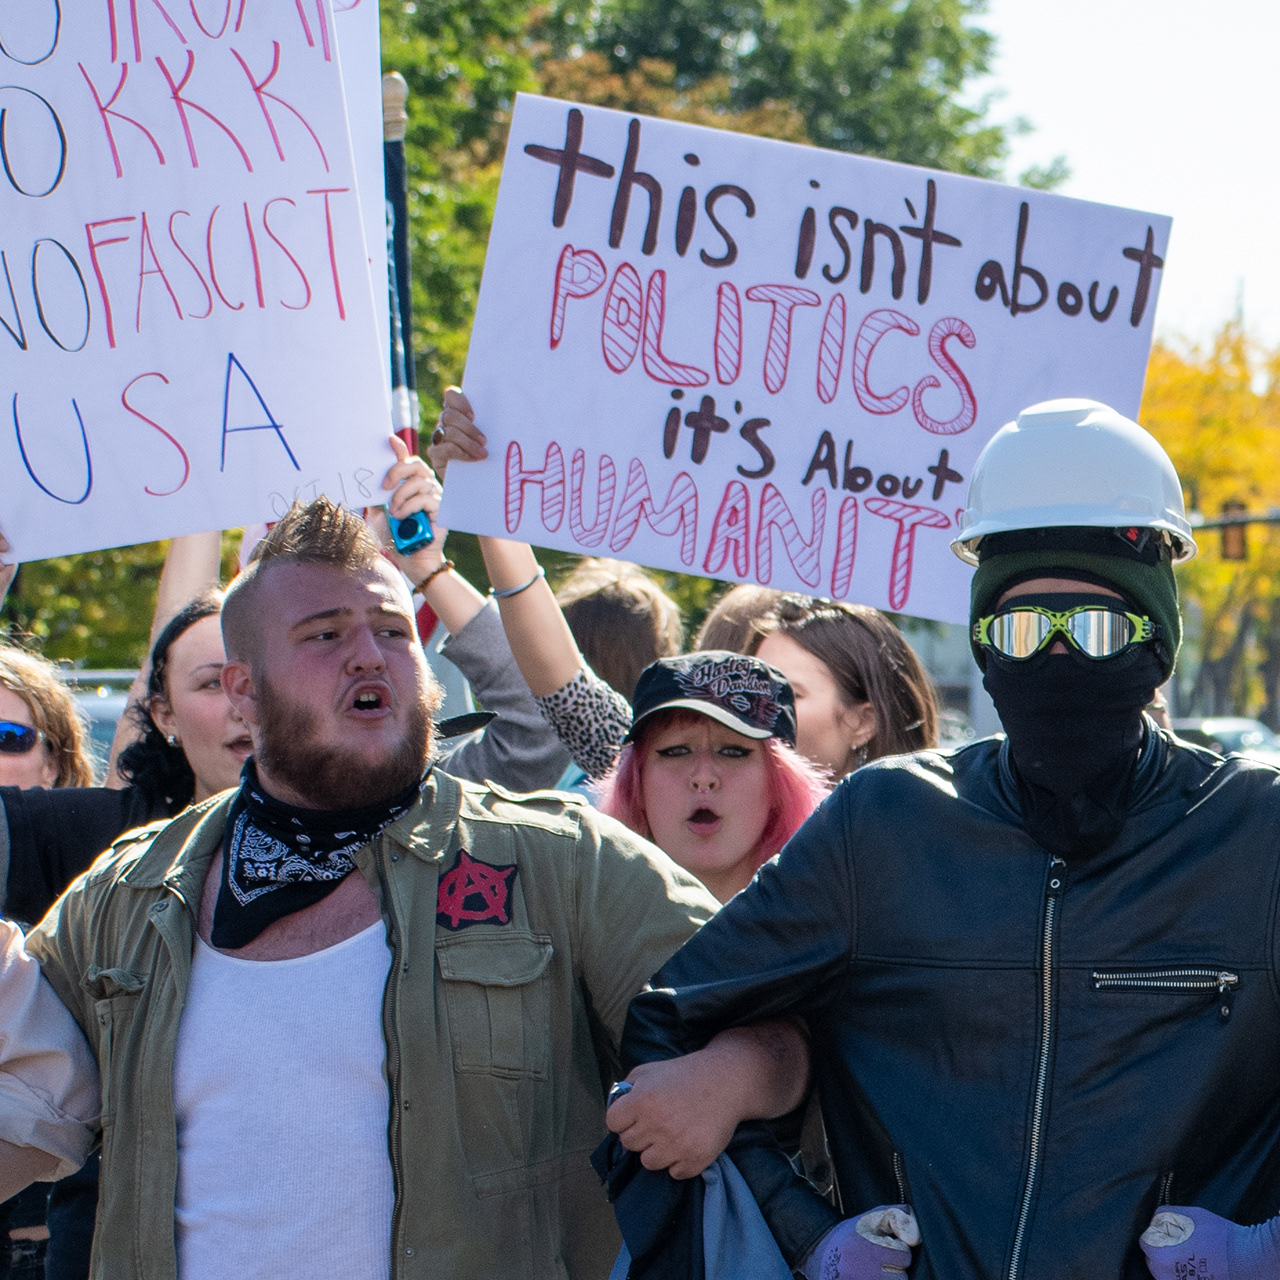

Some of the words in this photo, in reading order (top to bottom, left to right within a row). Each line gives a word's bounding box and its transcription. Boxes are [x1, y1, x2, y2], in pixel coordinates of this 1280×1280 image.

[77, 40, 331, 180] KKK
[85, 188, 350, 349] FASCIST
[524, 106, 756, 270] this
[795, 179, 962, 306] isn't
[974, 201, 1164, 328] about
[549, 242, 978, 436] POLITICS
[662, 388, 777, 481] it's
[802, 429, 964, 502] About
[504, 440, 964, 612] HUMANIT
[711, 674, 773, 698] Davidson
